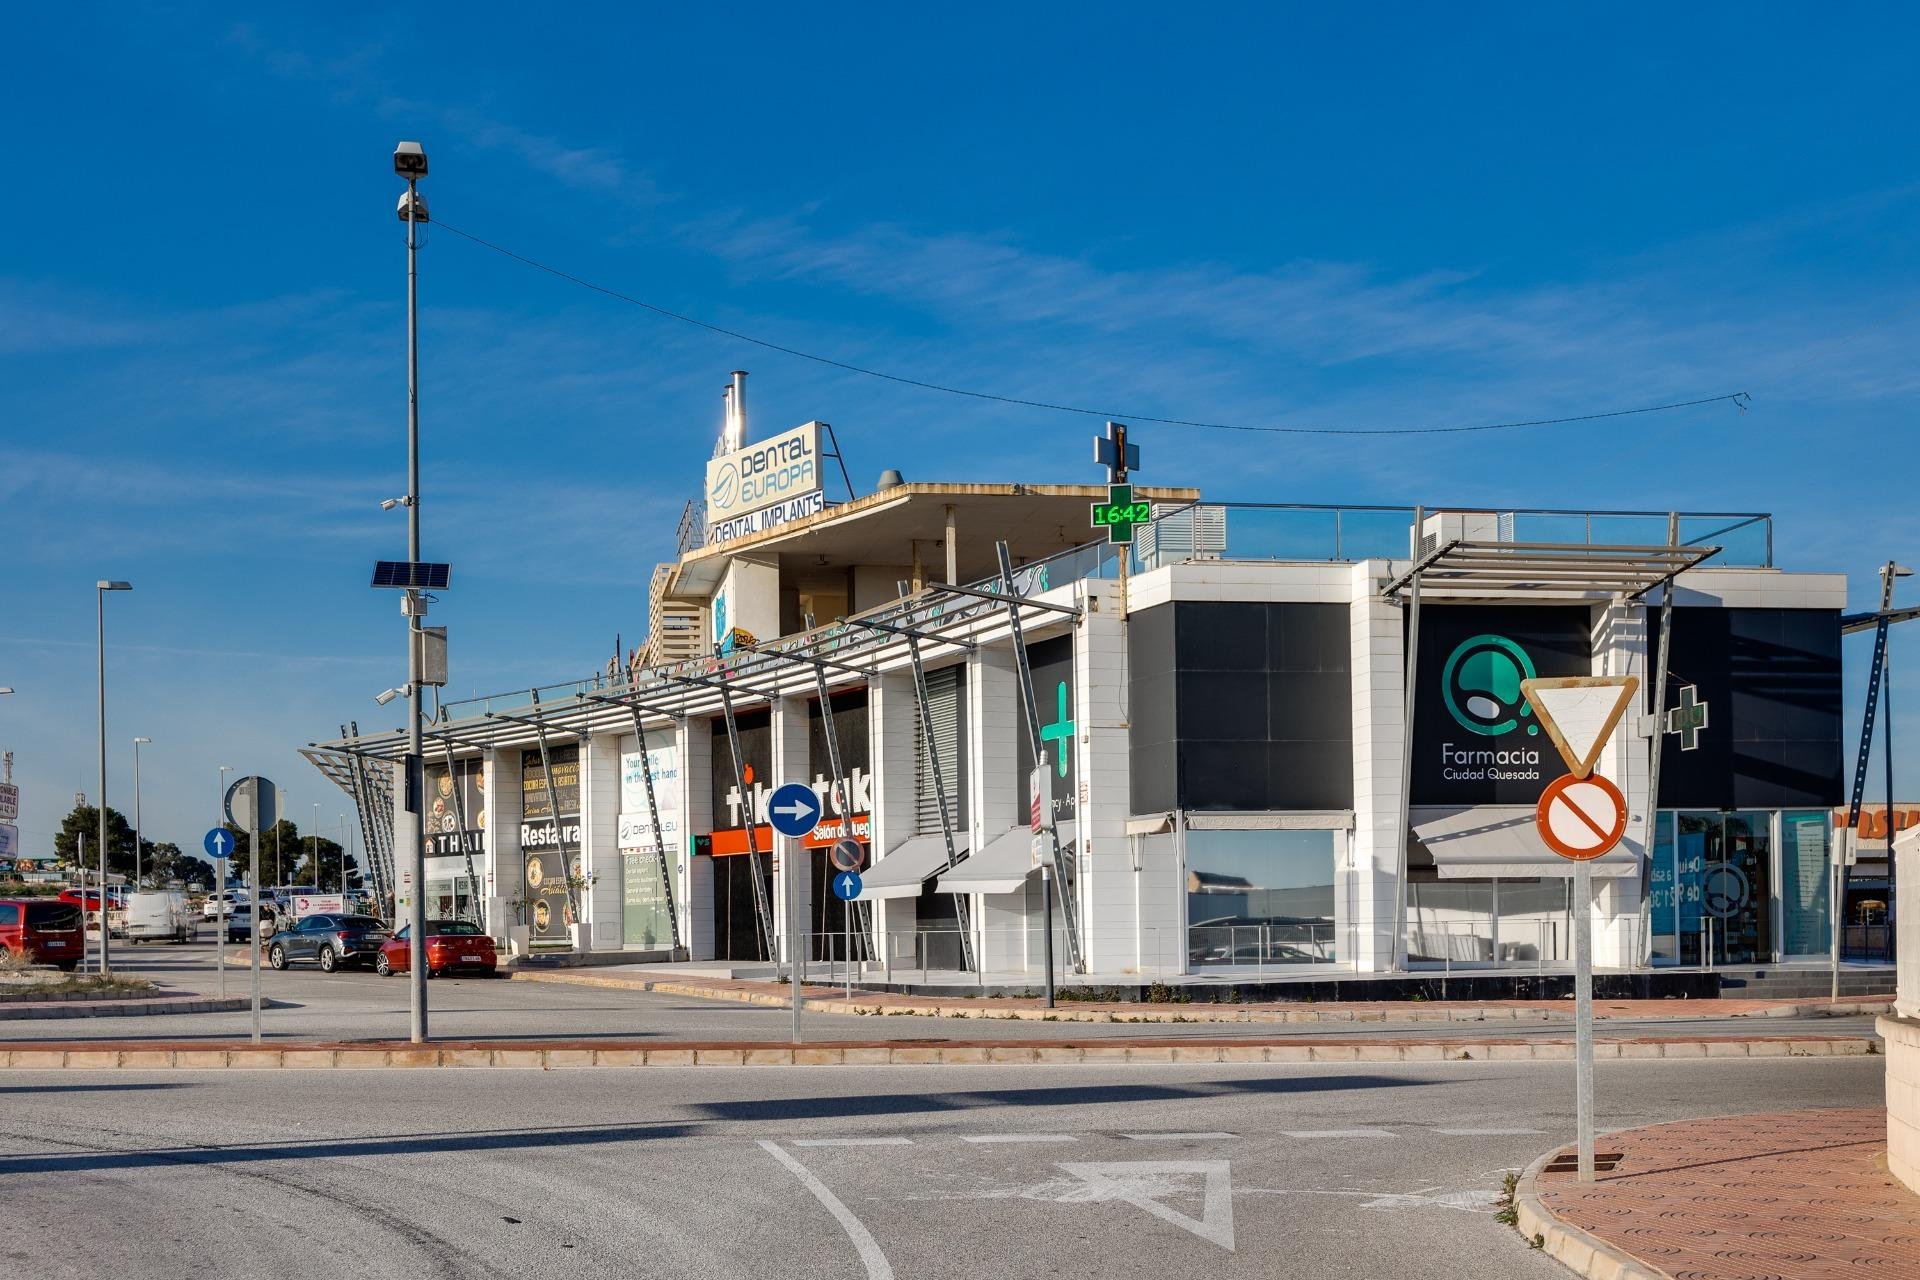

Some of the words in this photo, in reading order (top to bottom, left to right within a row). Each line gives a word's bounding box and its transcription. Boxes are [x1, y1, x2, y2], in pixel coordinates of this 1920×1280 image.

[741, 459, 814, 502] EUROPA
[715, 515, 758, 543] DENTAL
[761, 492, 822, 530] IMPLANTS
[1095, 504, 1149, 524] 16:42
[625, 757, 640, 769] Your
[1442, 743, 1539, 765] Farmacia
[1443, 767, 1485, 780] Ciudad
[1487, 767, 1539, 780] Quesada
[813, 824, 837, 841] Salón
